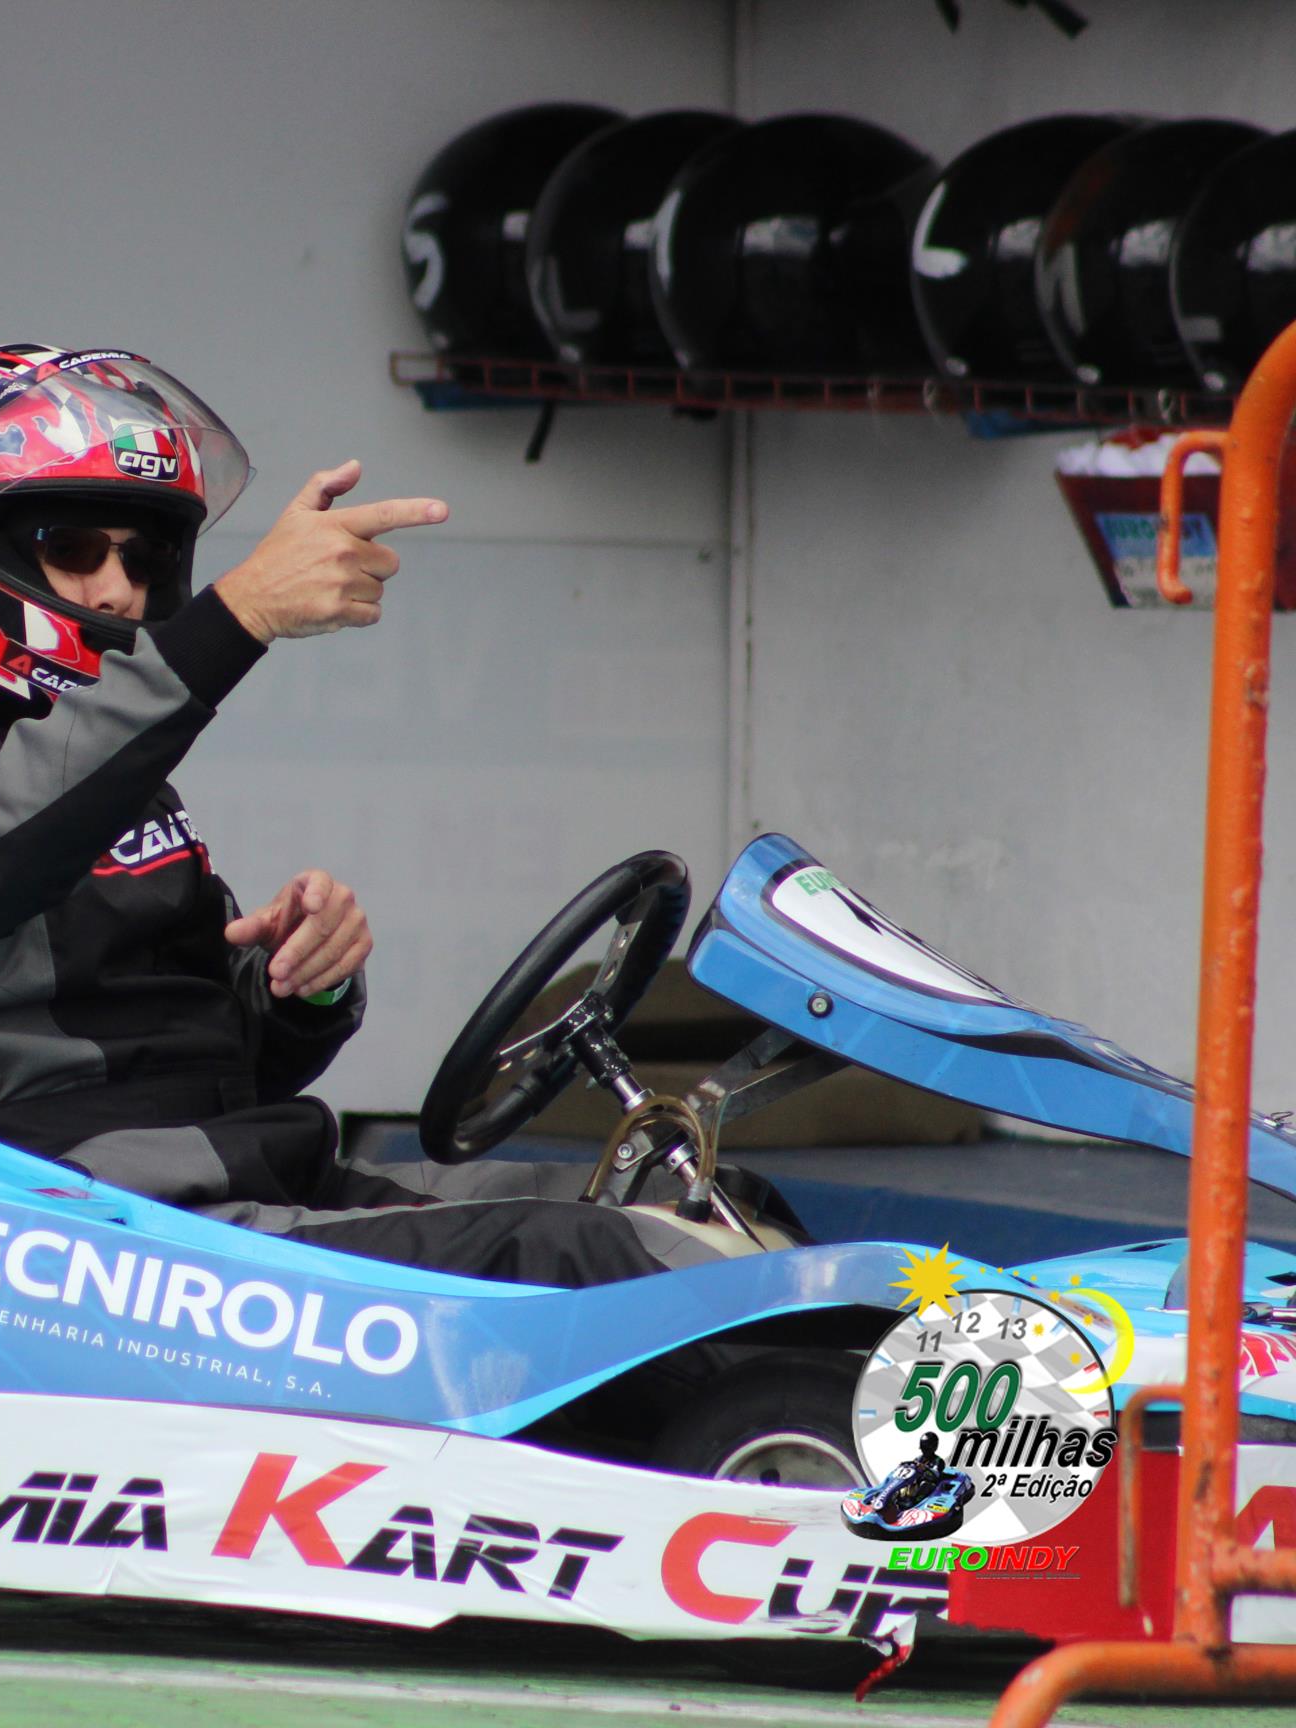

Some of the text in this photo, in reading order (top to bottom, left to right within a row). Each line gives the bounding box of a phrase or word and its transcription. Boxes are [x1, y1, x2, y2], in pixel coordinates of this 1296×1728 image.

[118, 451, 177, 477] agv
[6, 654, 83, 691] ACAD
[117, 1337, 273, 1387] INDUSTRIAL,
[286, 1375, 333, 1399] S.A.
